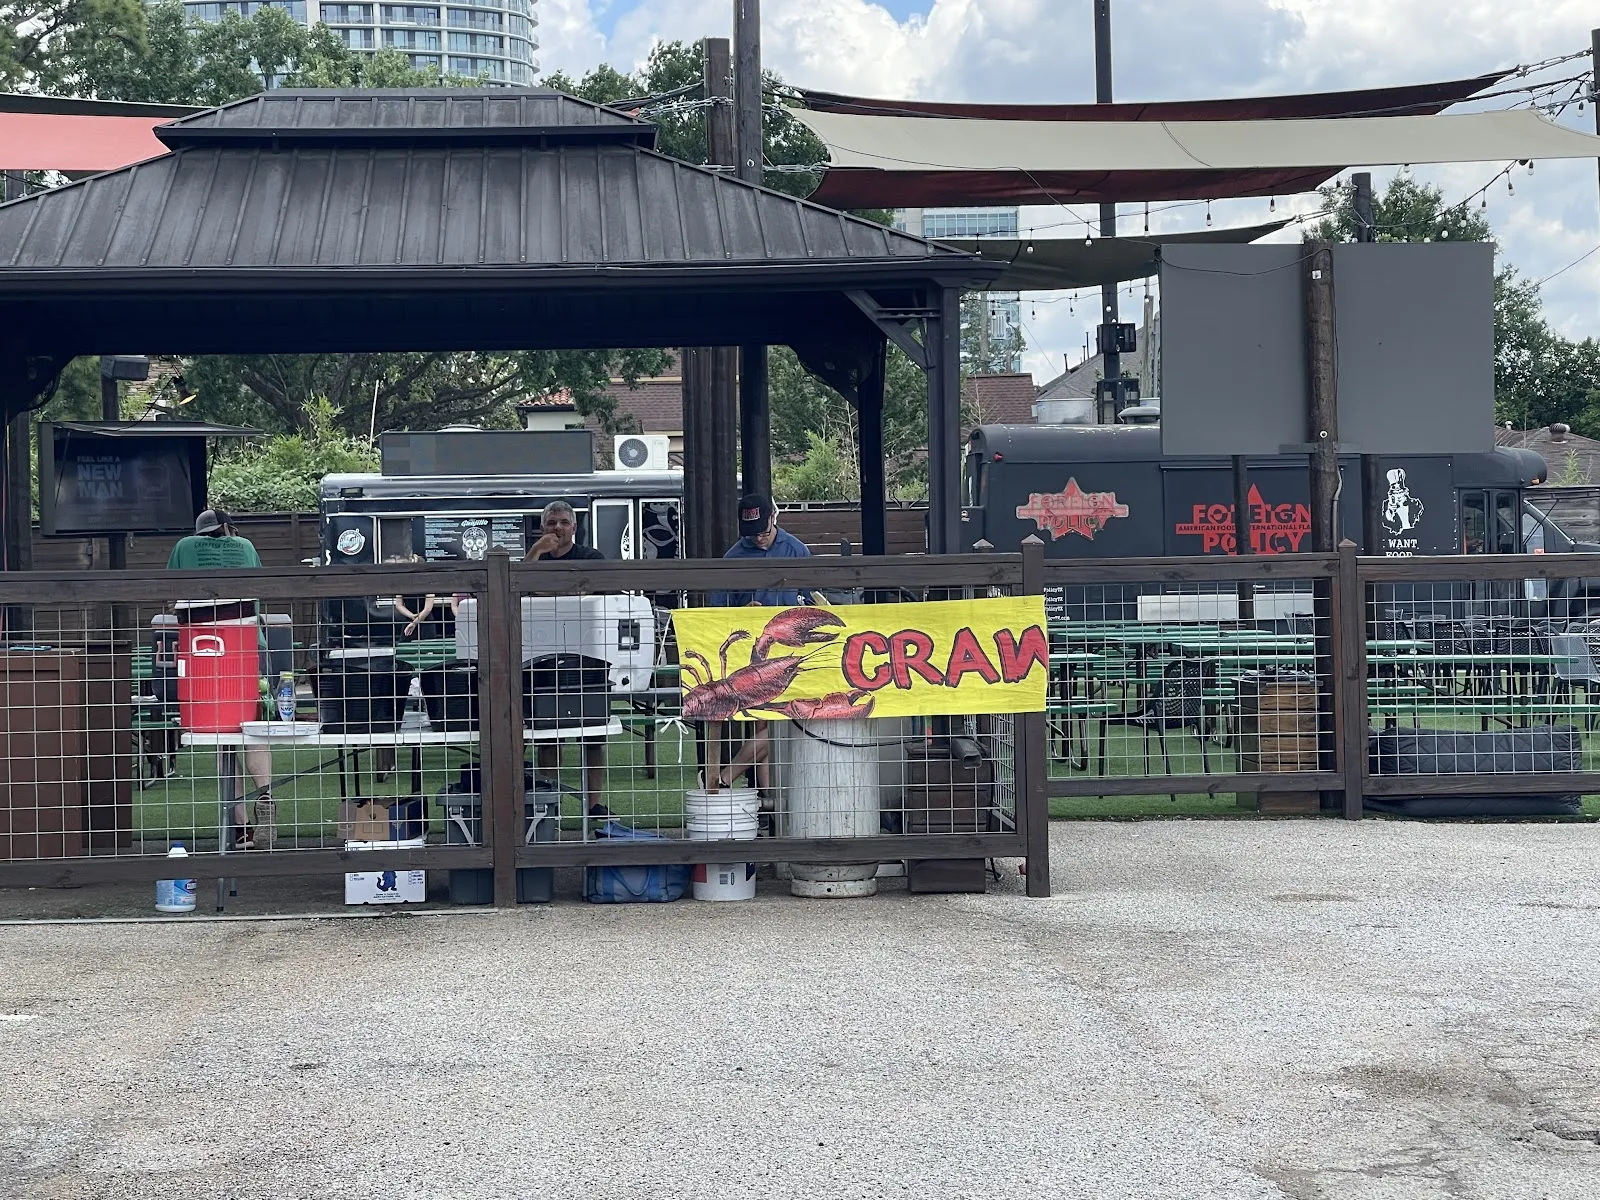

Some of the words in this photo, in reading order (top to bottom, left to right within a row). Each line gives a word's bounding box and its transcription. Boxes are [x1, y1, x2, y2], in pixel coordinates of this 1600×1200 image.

[77, 455, 95, 463] FEEL
[77, 464, 122, 480] NEW
[78, 481, 123, 498] MAN
[1029, 494, 1116, 509] FOREIGN
[1038, 515, 1106, 529] POLICY
[1388, 539, 1418, 548] WANT
[842, 624, 1049, 692] CRAW
